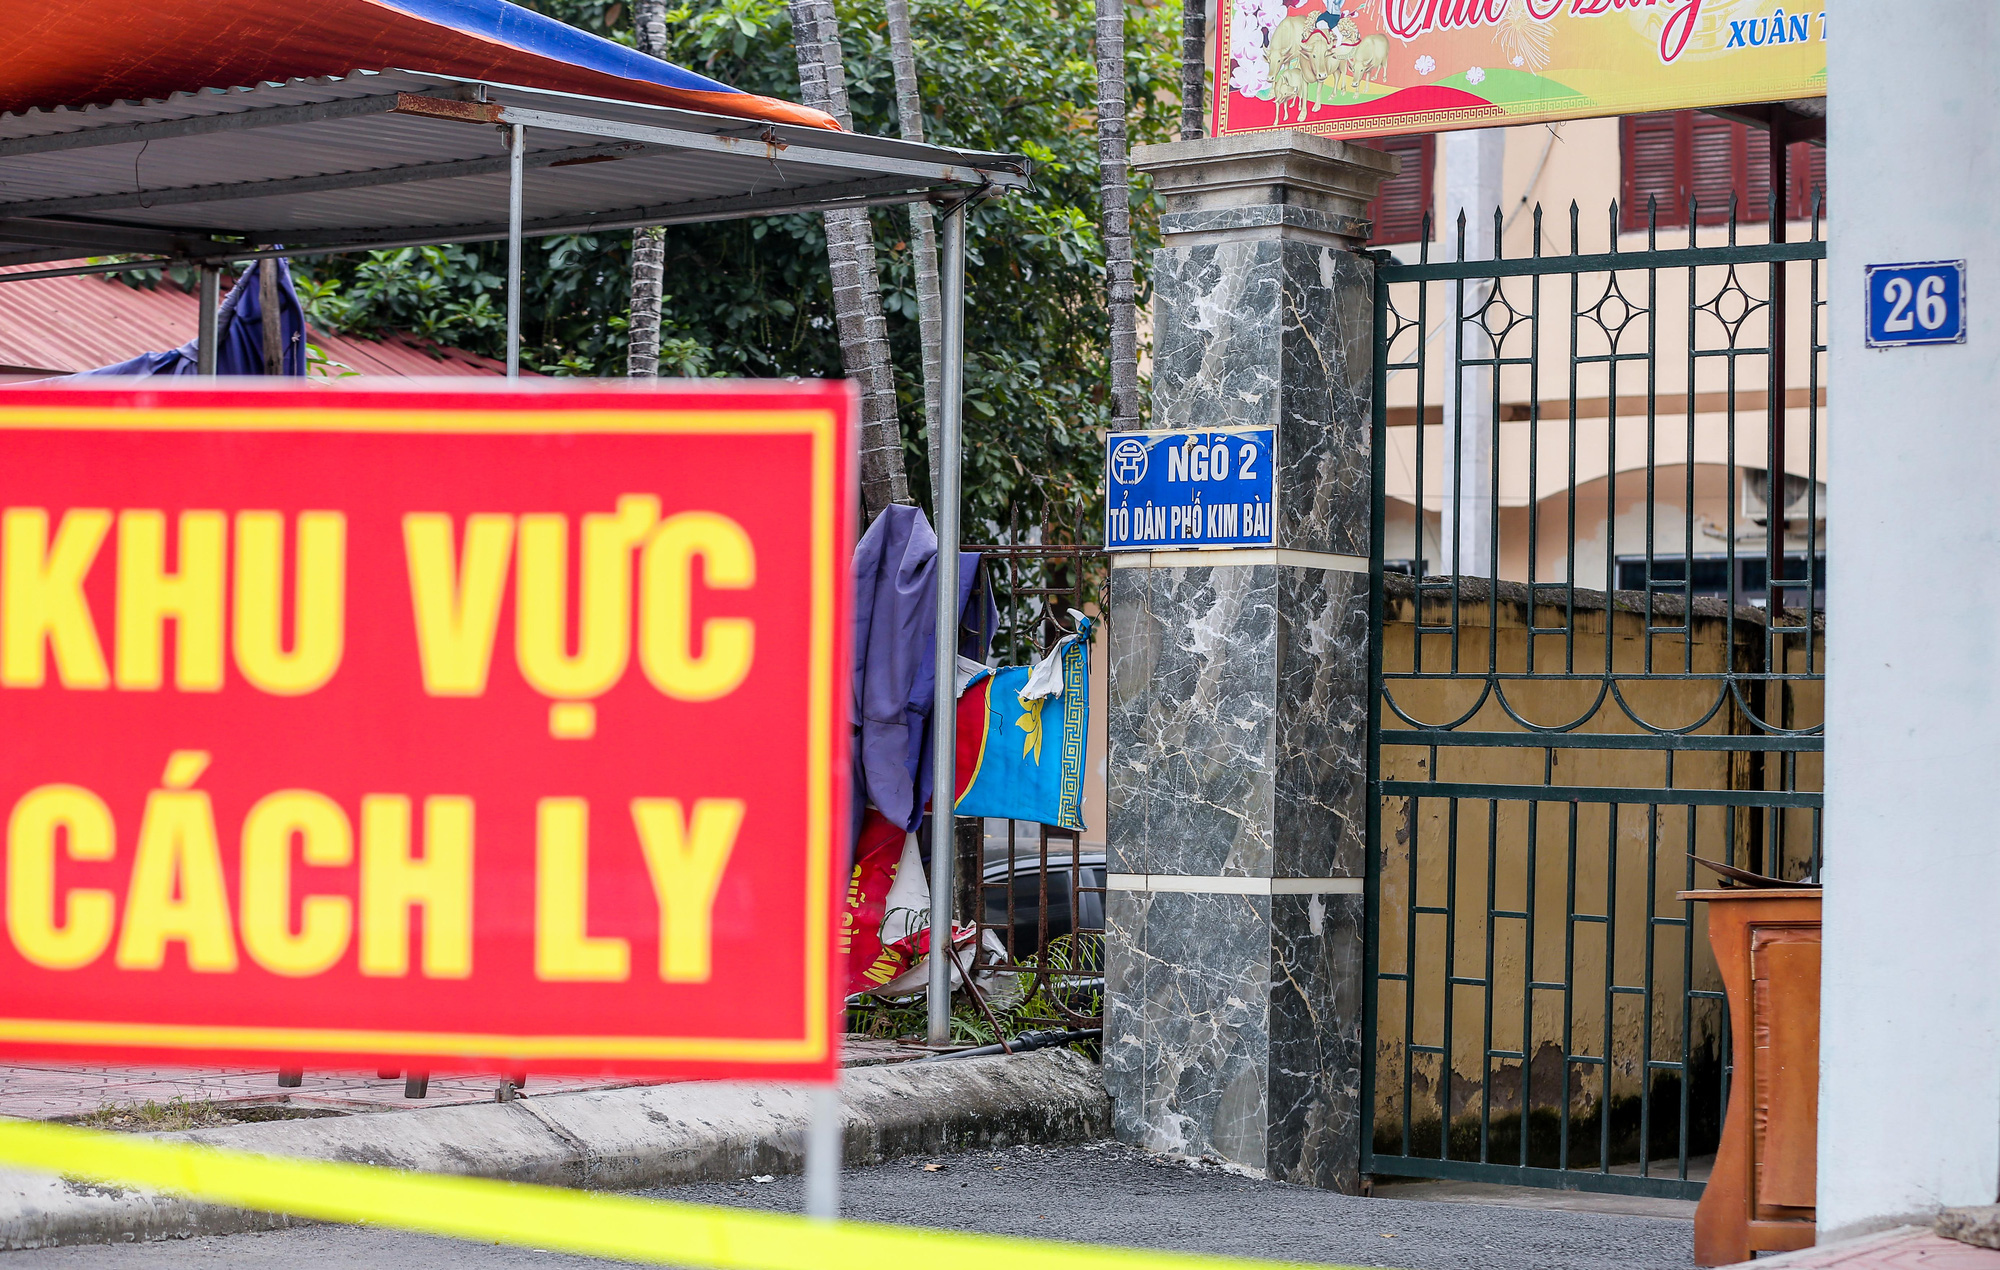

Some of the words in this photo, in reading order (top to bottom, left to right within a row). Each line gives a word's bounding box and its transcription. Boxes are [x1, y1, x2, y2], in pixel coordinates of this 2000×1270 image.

[1726, 8, 1809, 48] XUÂN
[1883, 275, 1947, 333] 26
[1167, 436, 1230, 482] NGÕ
[1238, 443, 1258, 480] 2
[1110, 489, 1129, 541] TỔ
[1133, 500, 1166, 541] DÂN
[1170, 491, 1203, 540] PHỐ
[1207, 503, 1238, 538] KIM
[1242, 494, 1270, 537] BÀI
[0, 507, 347, 697] KHU
[401, 493, 757, 740] VỰC
[5, 750, 475, 979] CÁCH
[534, 796, 746, 984] LY
